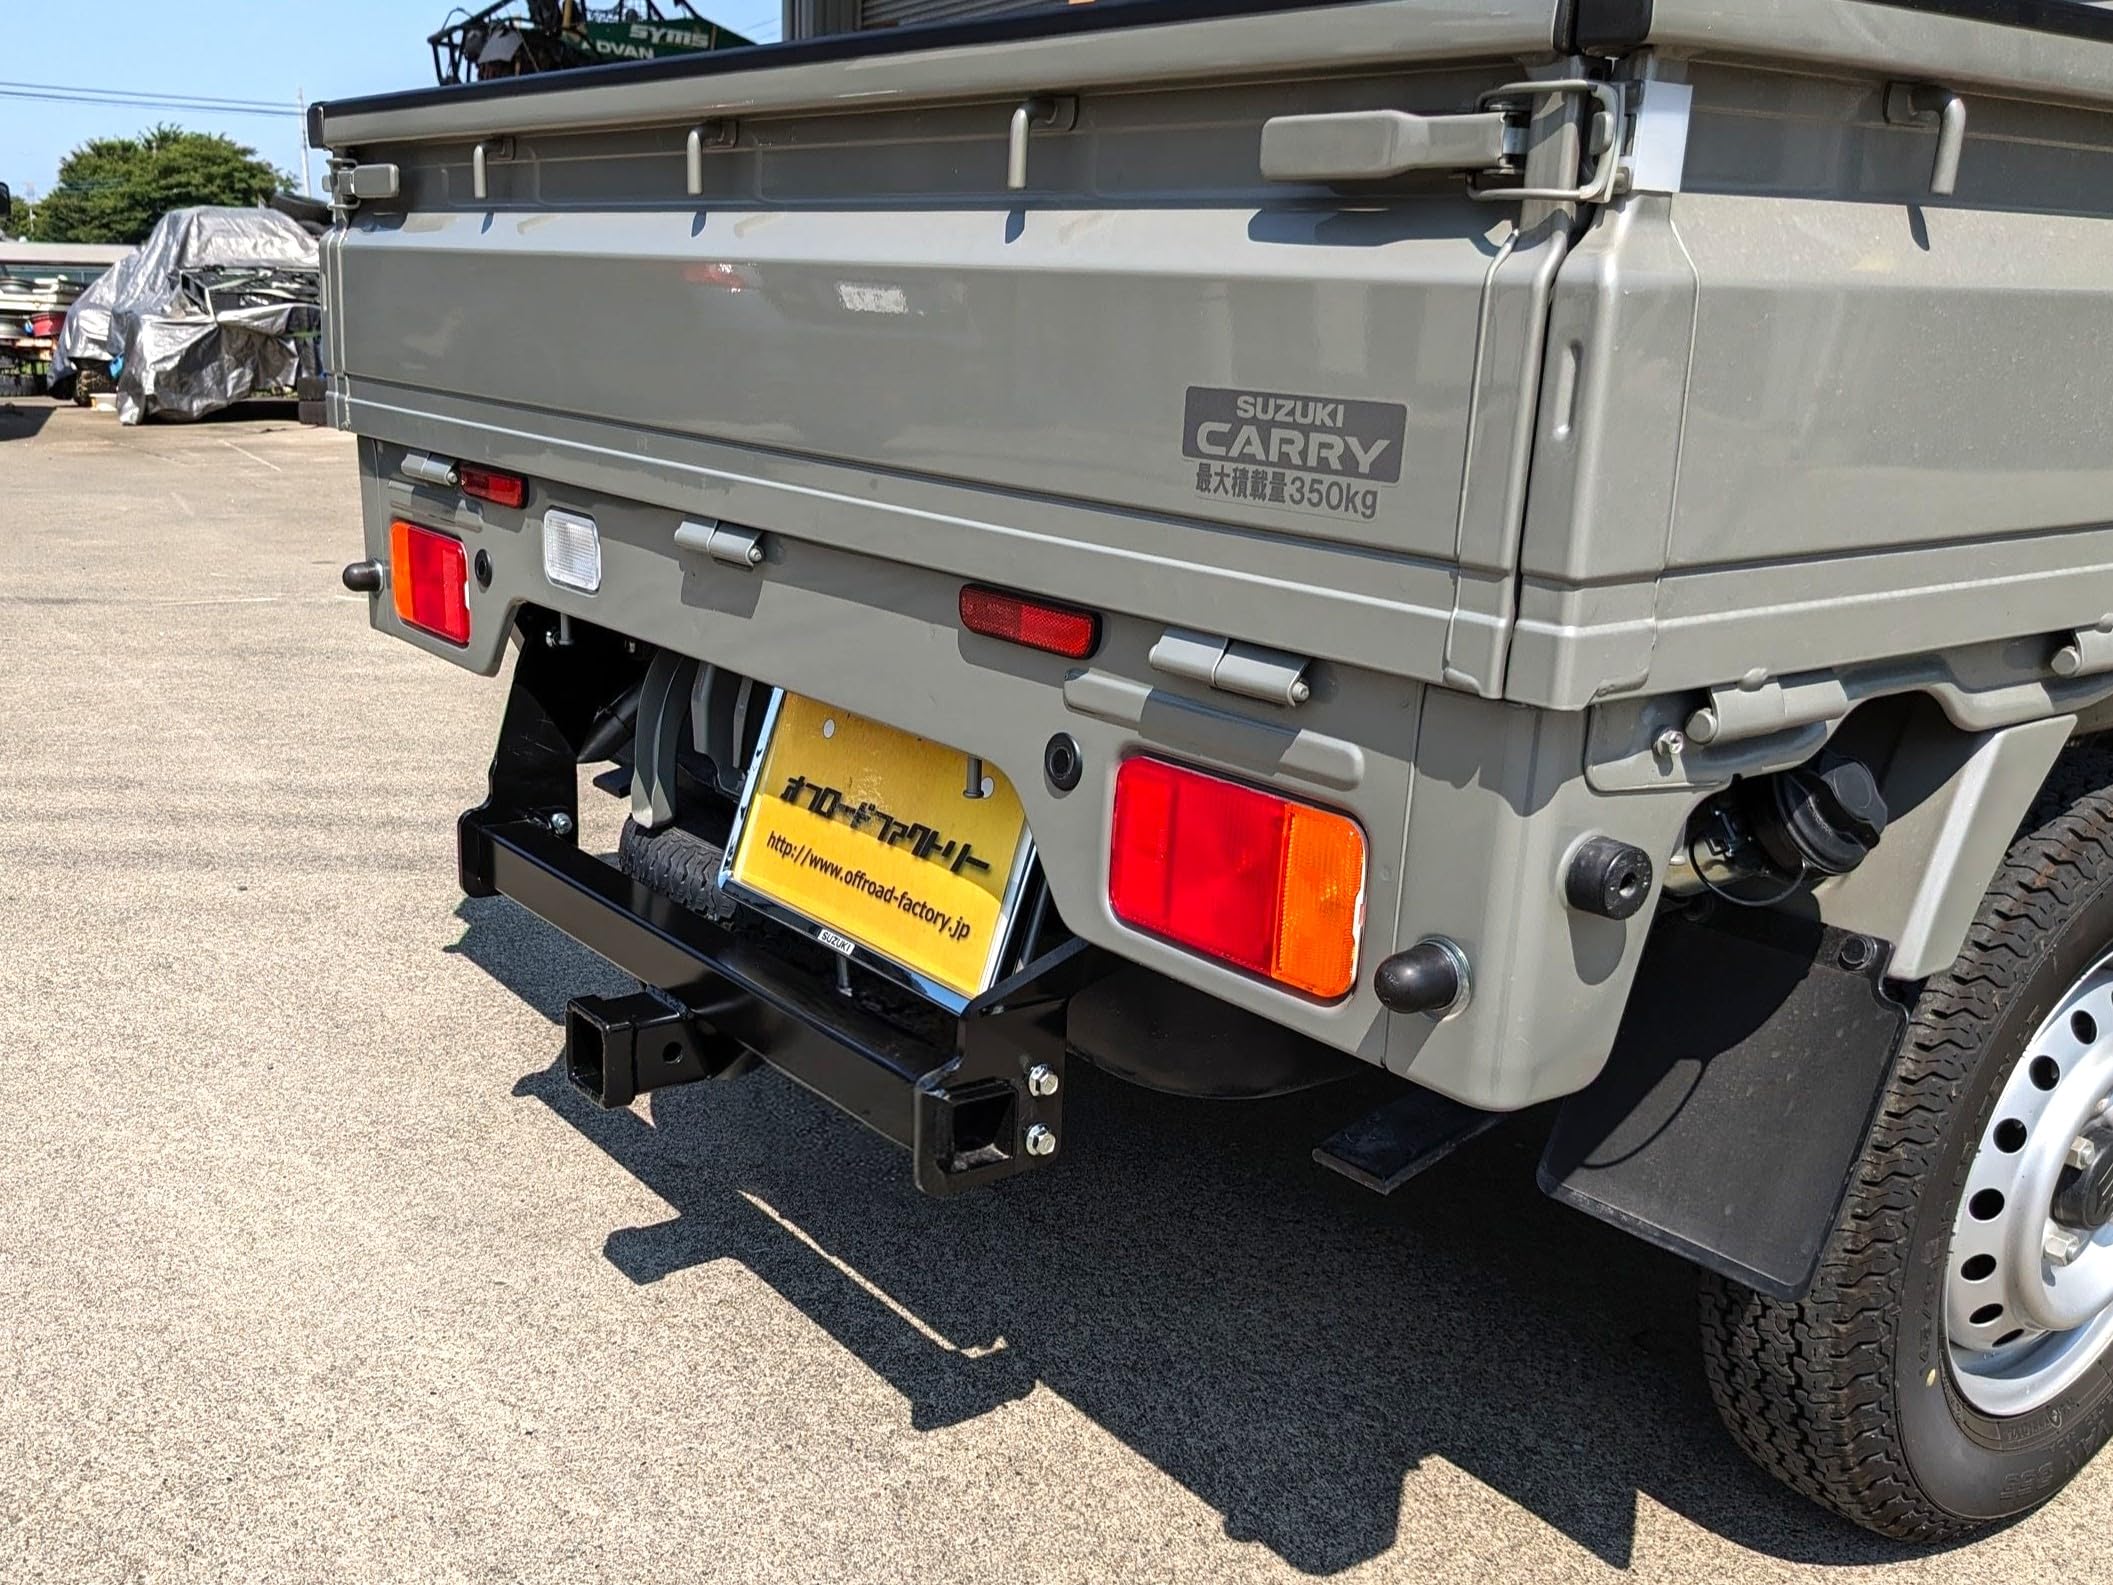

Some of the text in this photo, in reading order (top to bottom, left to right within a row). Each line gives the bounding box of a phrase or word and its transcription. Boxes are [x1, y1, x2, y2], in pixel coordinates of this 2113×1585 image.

[1236, 395, 1345, 428] SUZUKI
[1196, 421, 1391, 474] CARRY
[1195, 463, 1379, 520] 最大積載量350kg
[767, 831, 971, 941] http://www.offroad-factory.jp
[821, 930, 851, 952] SUZUKI
